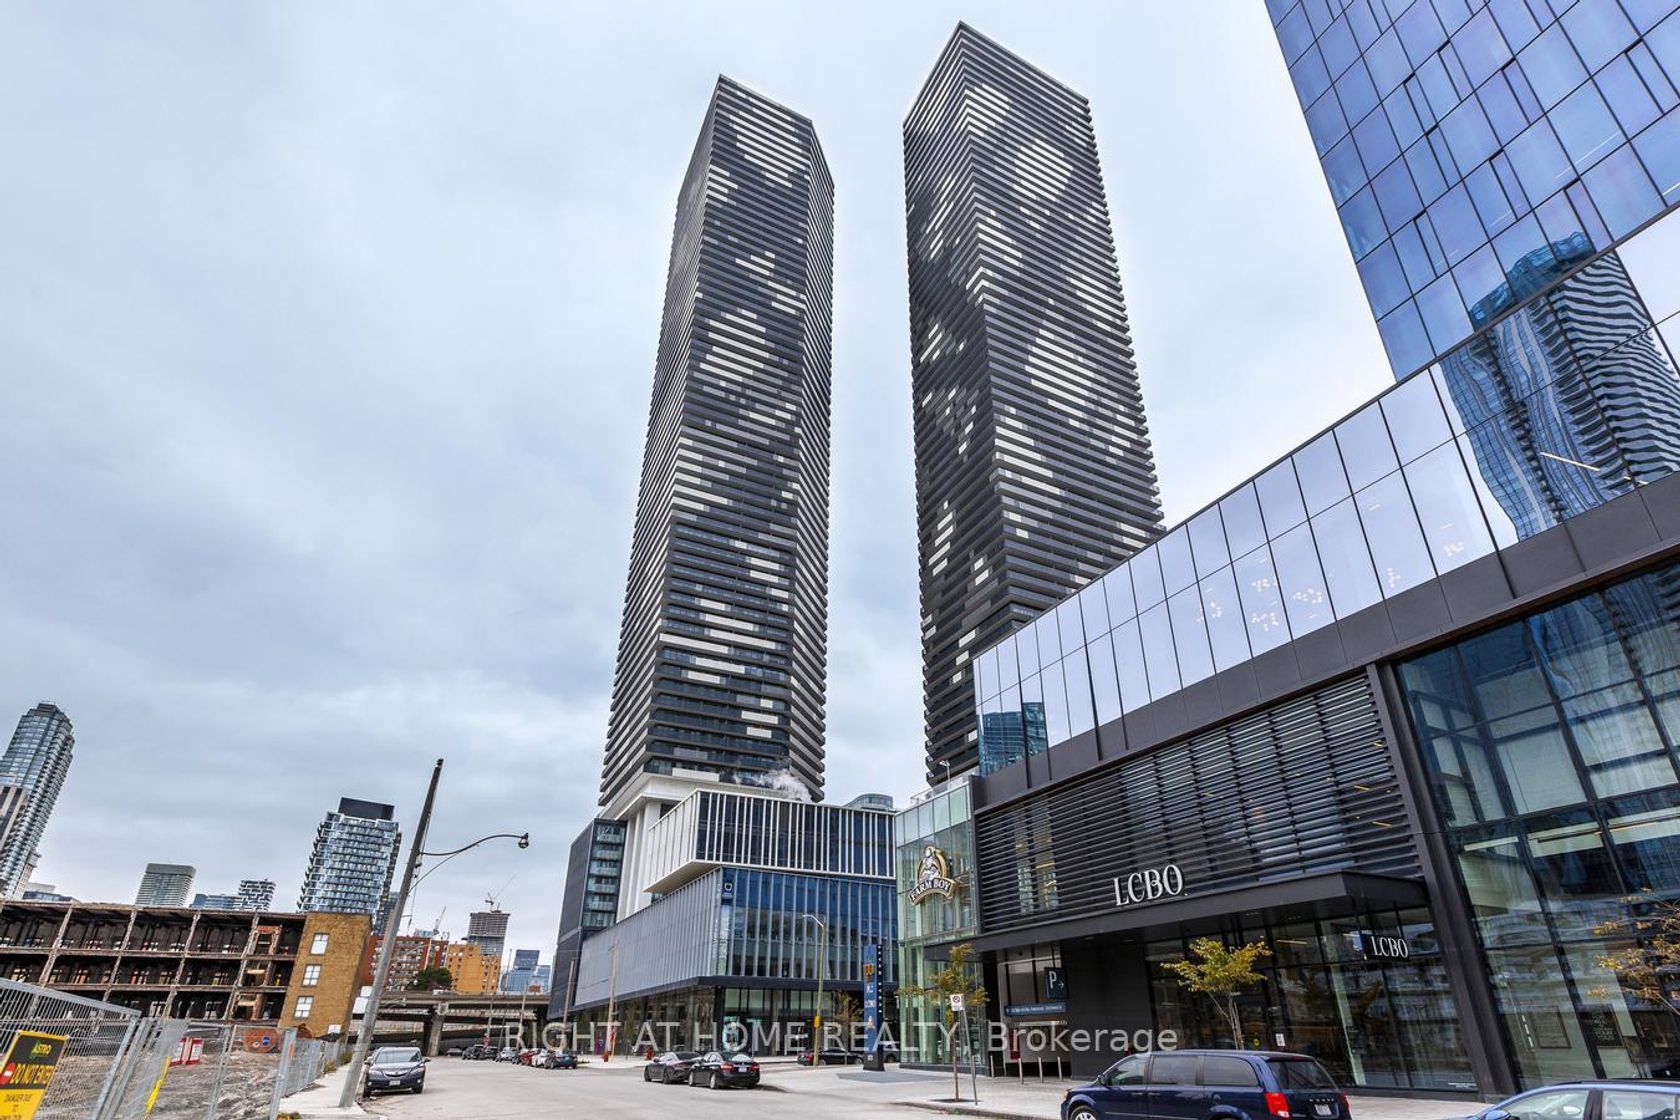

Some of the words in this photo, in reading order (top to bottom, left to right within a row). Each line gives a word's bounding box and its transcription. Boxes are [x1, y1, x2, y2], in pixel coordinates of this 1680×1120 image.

[910, 879, 933, 901] FARM
[933, 879, 951, 891] BOY
[1113, 864, 1184, 906] LCBO
[1371, 936, 1409, 958] LCBO
[1048, 970, 1057, 989] P
